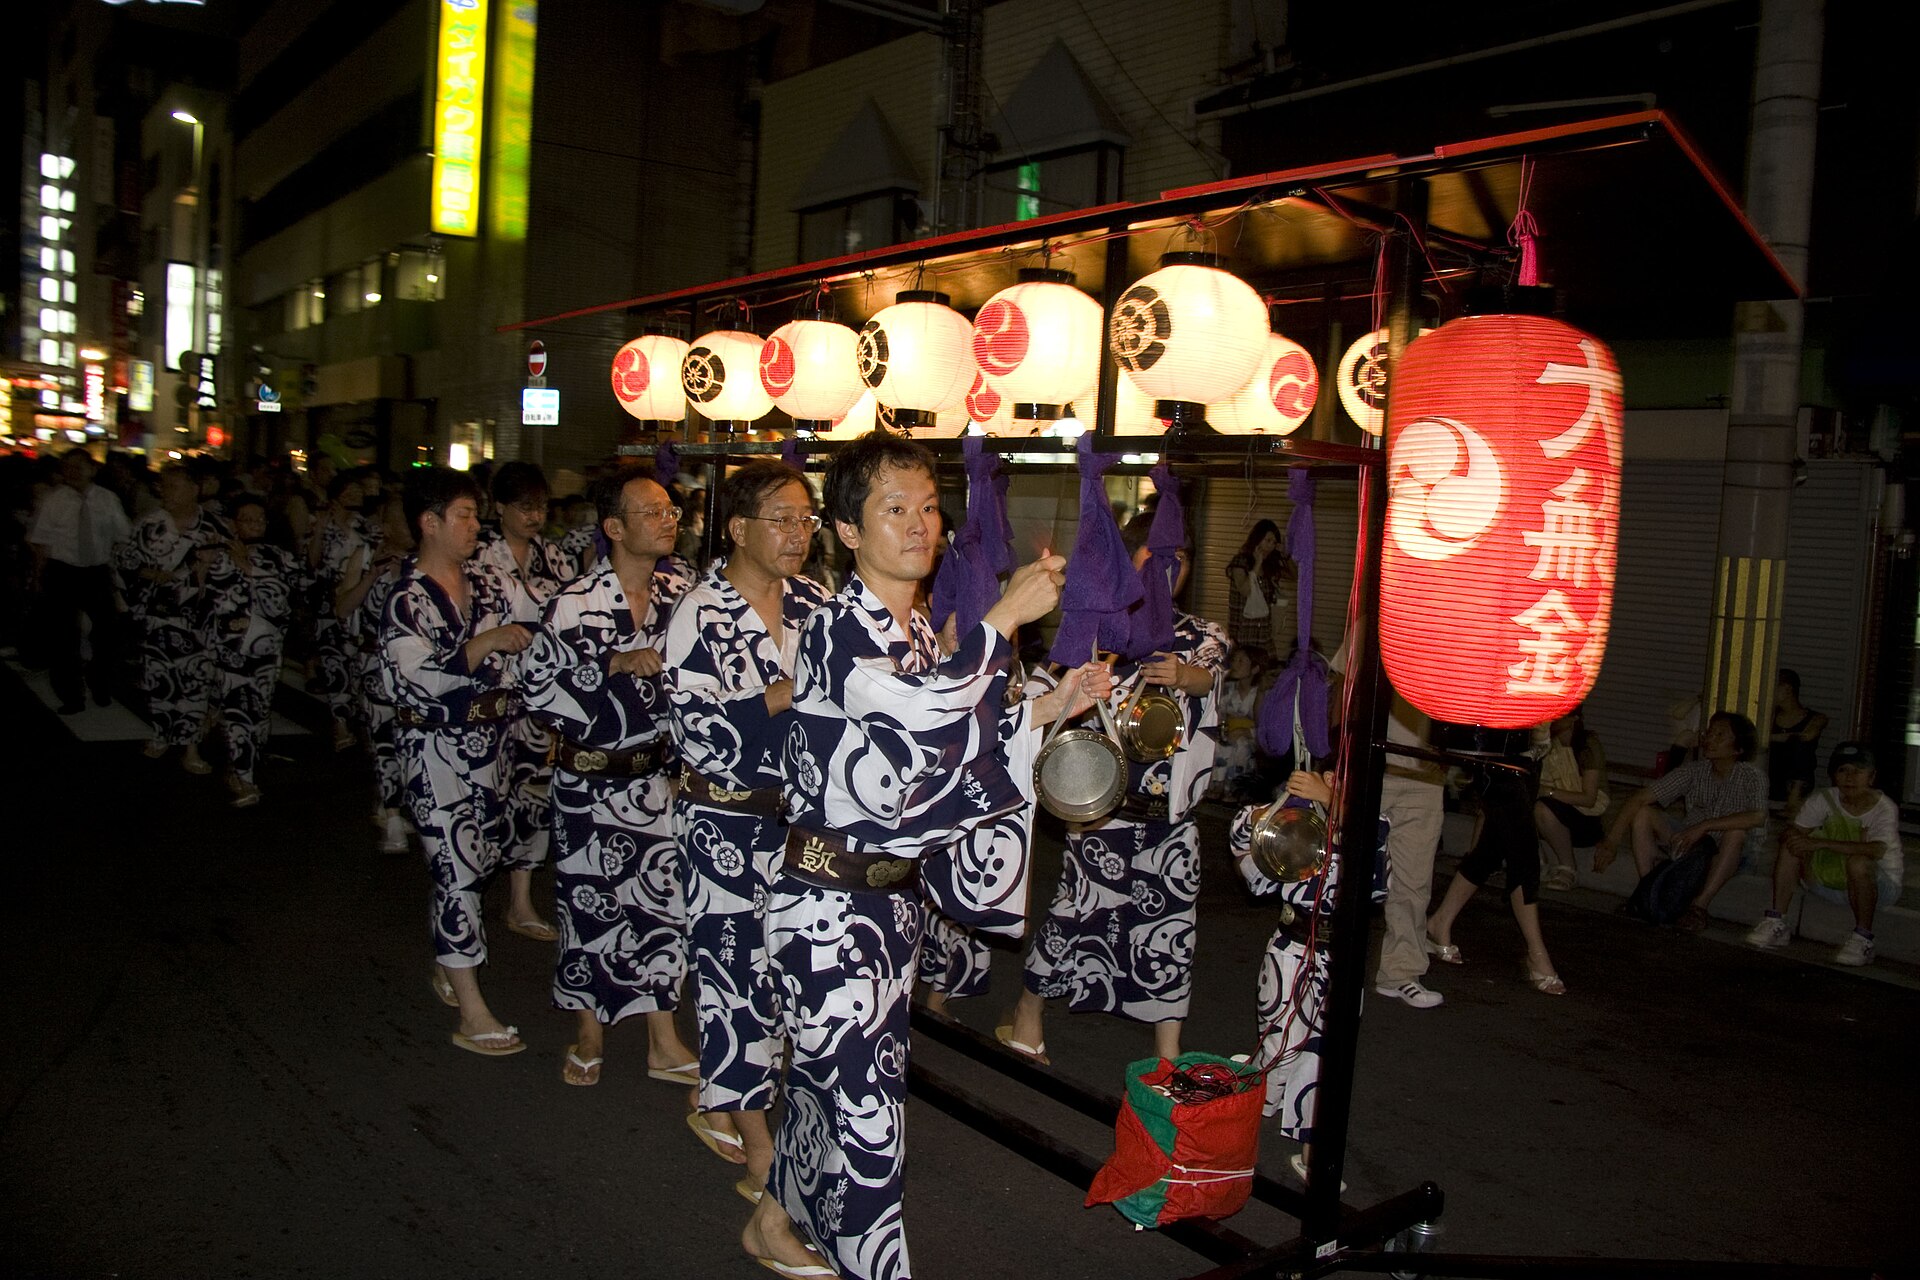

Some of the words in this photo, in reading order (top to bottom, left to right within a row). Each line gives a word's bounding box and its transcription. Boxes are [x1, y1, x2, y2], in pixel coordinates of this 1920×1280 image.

[797, 836, 841, 879] 凱
[719, 916, 737, 967] 大船鉾
[1106, 910, 1121, 948] 大船鉾
